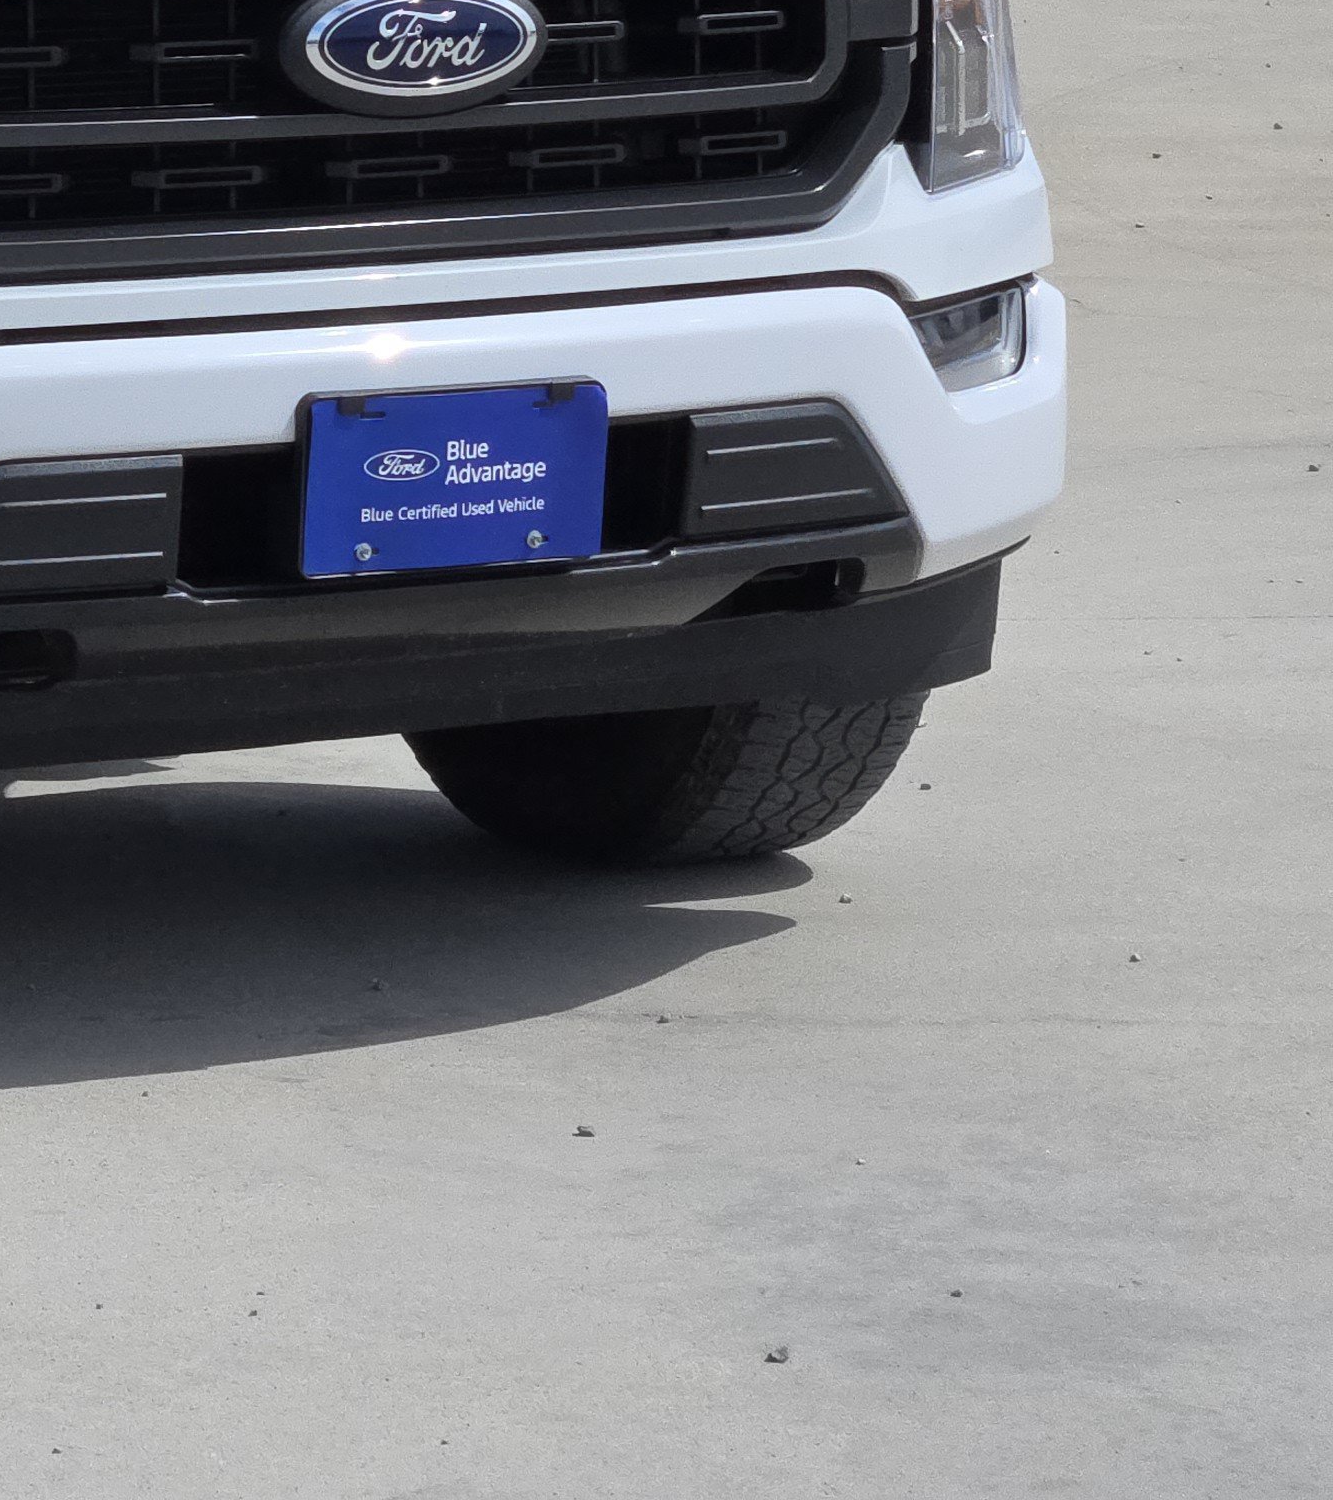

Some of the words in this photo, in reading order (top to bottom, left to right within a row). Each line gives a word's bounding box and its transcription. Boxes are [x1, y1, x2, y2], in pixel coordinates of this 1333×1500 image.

[366, 8, 488, 71] Ford
[446, 439, 490, 461] Blue
[377, 453, 426, 477] Ford
[444, 459, 547, 486] Advantage
[360, 507, 394, 523] Blue
[397, 502, 458, 521] Certified
[461, 499, 495, 517] Used
[497, 496, 546, 514] Vehicle
